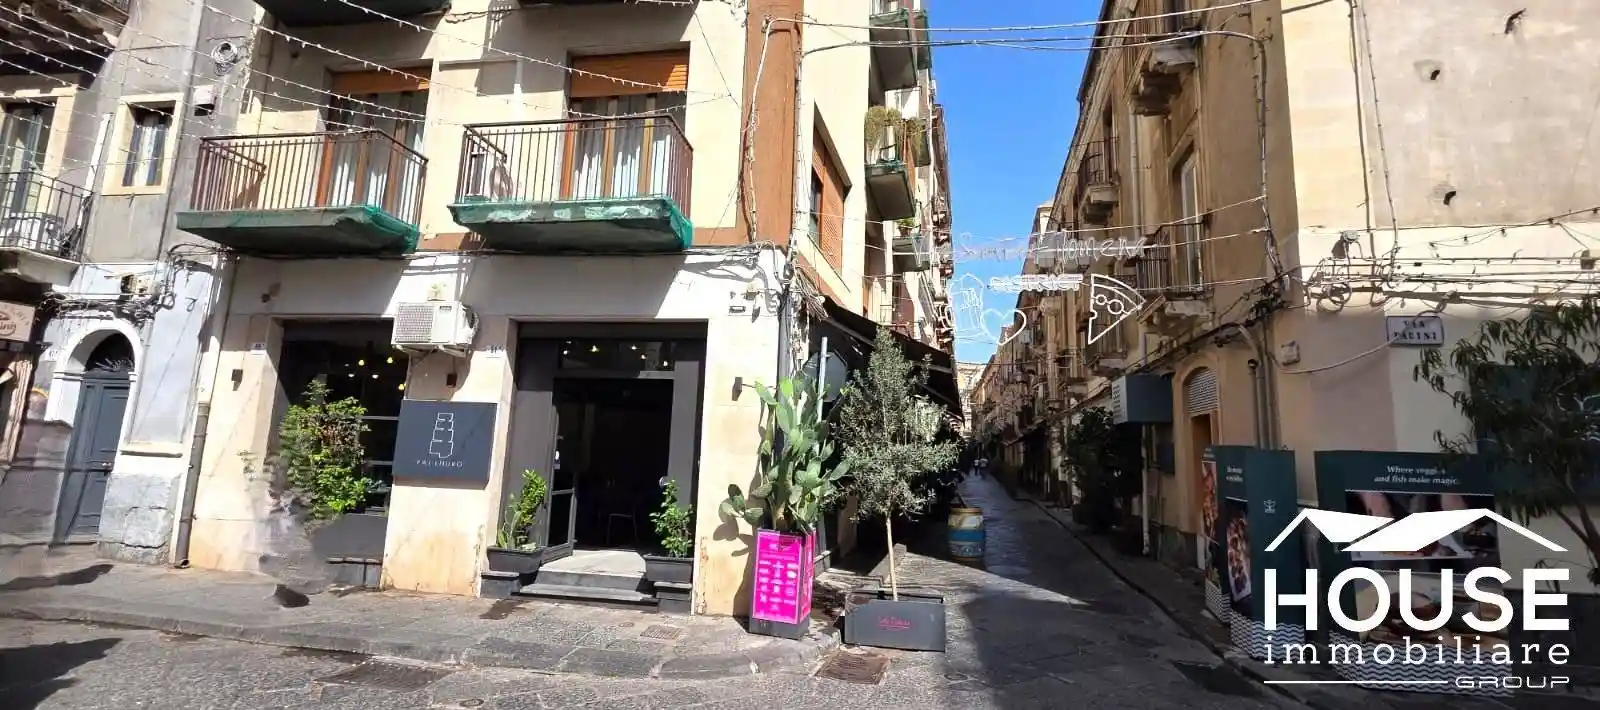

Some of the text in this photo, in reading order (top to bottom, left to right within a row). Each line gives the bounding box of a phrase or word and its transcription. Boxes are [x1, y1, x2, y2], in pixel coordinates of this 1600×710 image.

[1403, 320, 1425, 329] VIA
[1386, 464, 1446, 476] Where veggis
[1374, 475, 1390, 483] and
